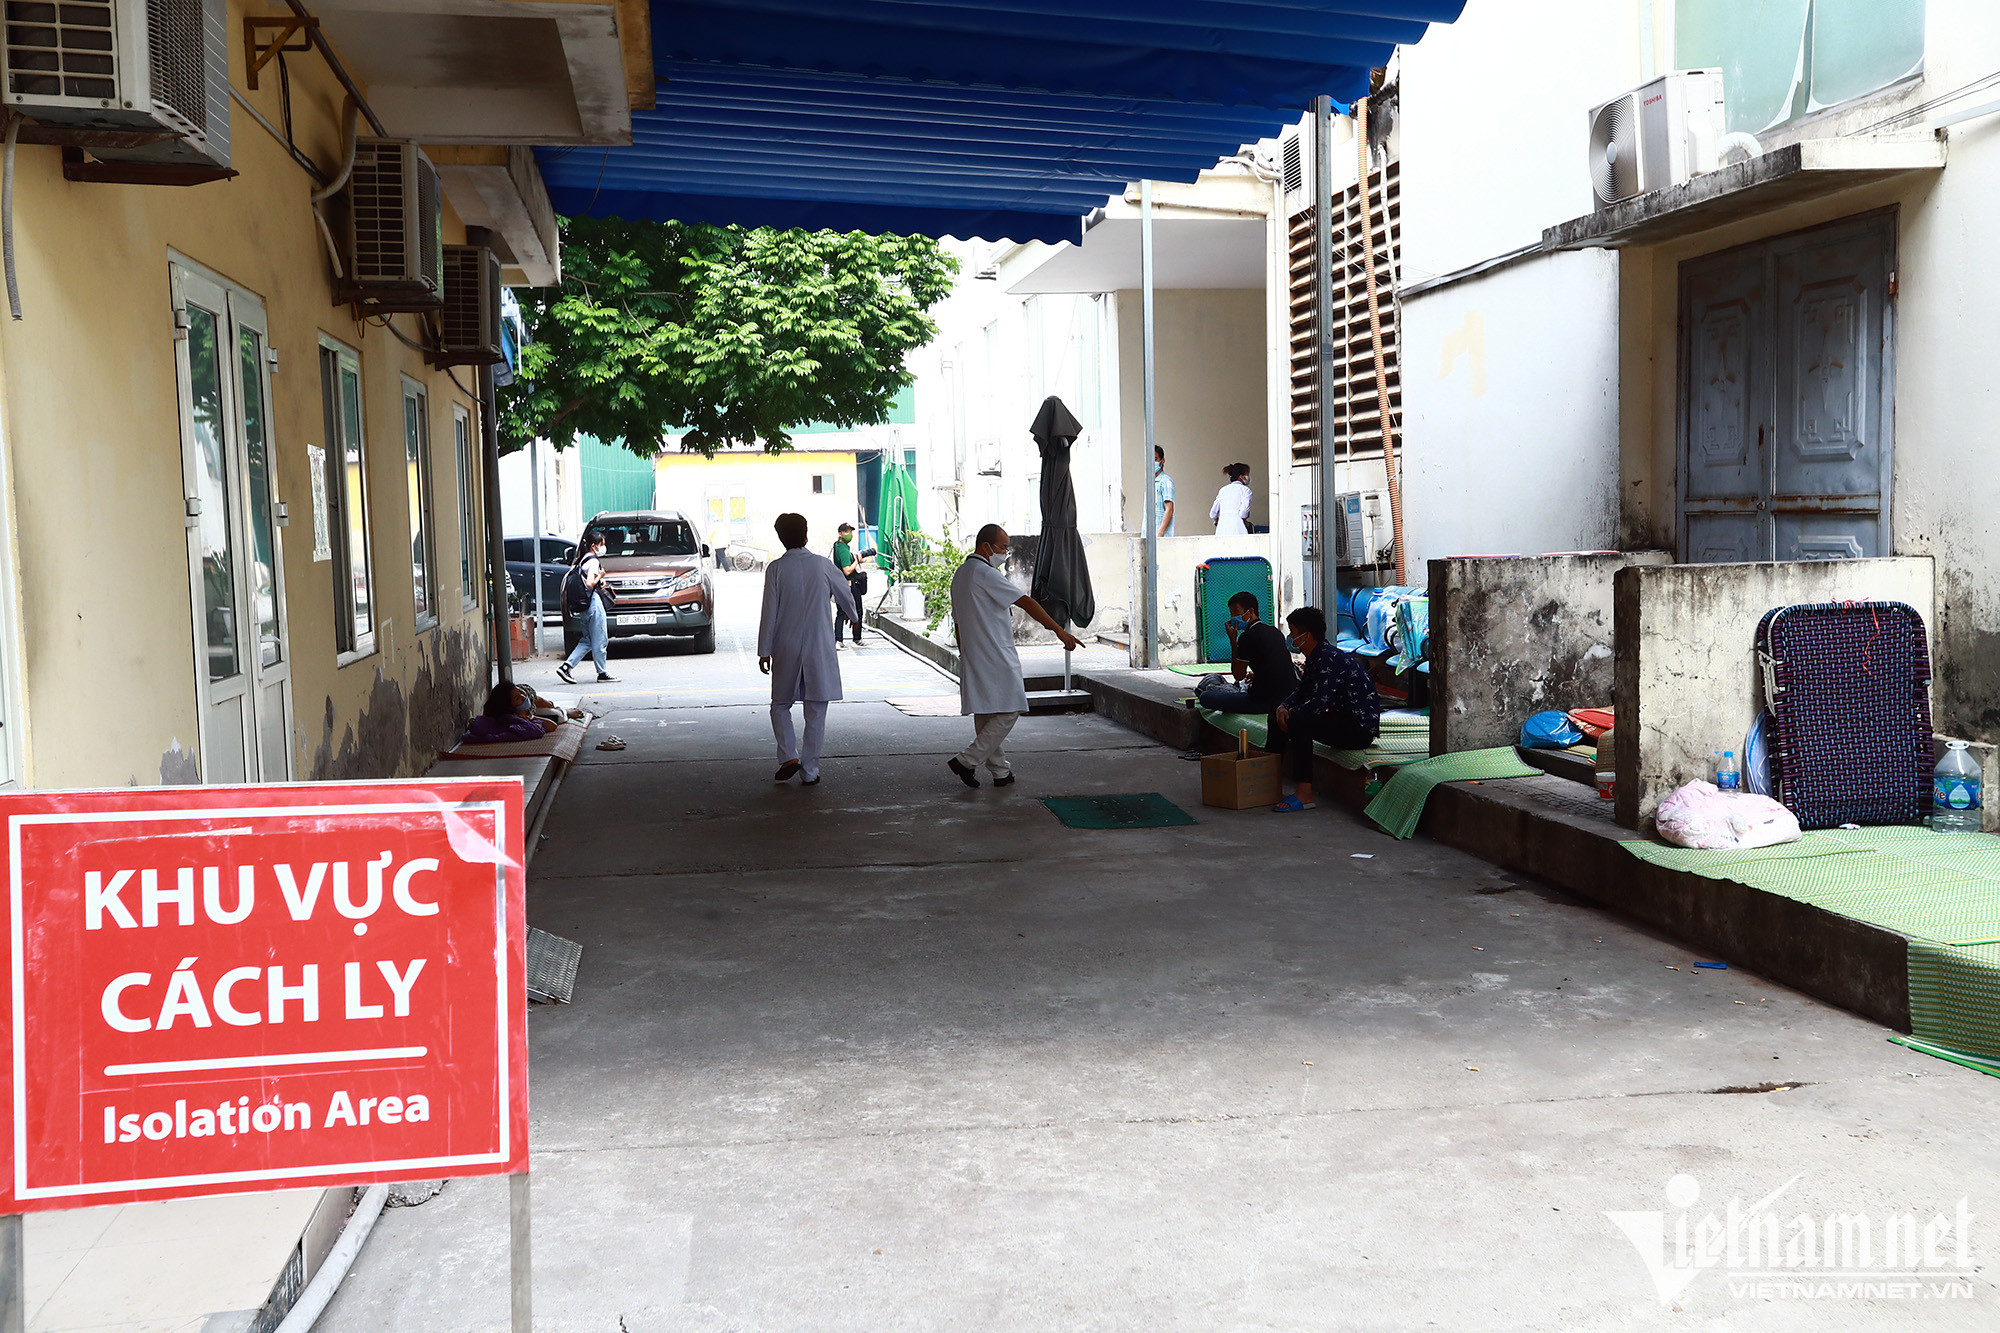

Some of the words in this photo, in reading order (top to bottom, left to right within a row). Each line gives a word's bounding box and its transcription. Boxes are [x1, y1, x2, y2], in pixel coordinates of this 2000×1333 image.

[1643, 94, 1662, 106] TOSHIBA
[85, 863, 254, 930] KHU
[273, 851, 439, 935] VỰC
[102, 957, 318, 1032] CÁCH
[345, 959, 426, 1019] LY
[104, 1096, 311, 1144] Isolation
[324, 1091, 430, 1128] Area
